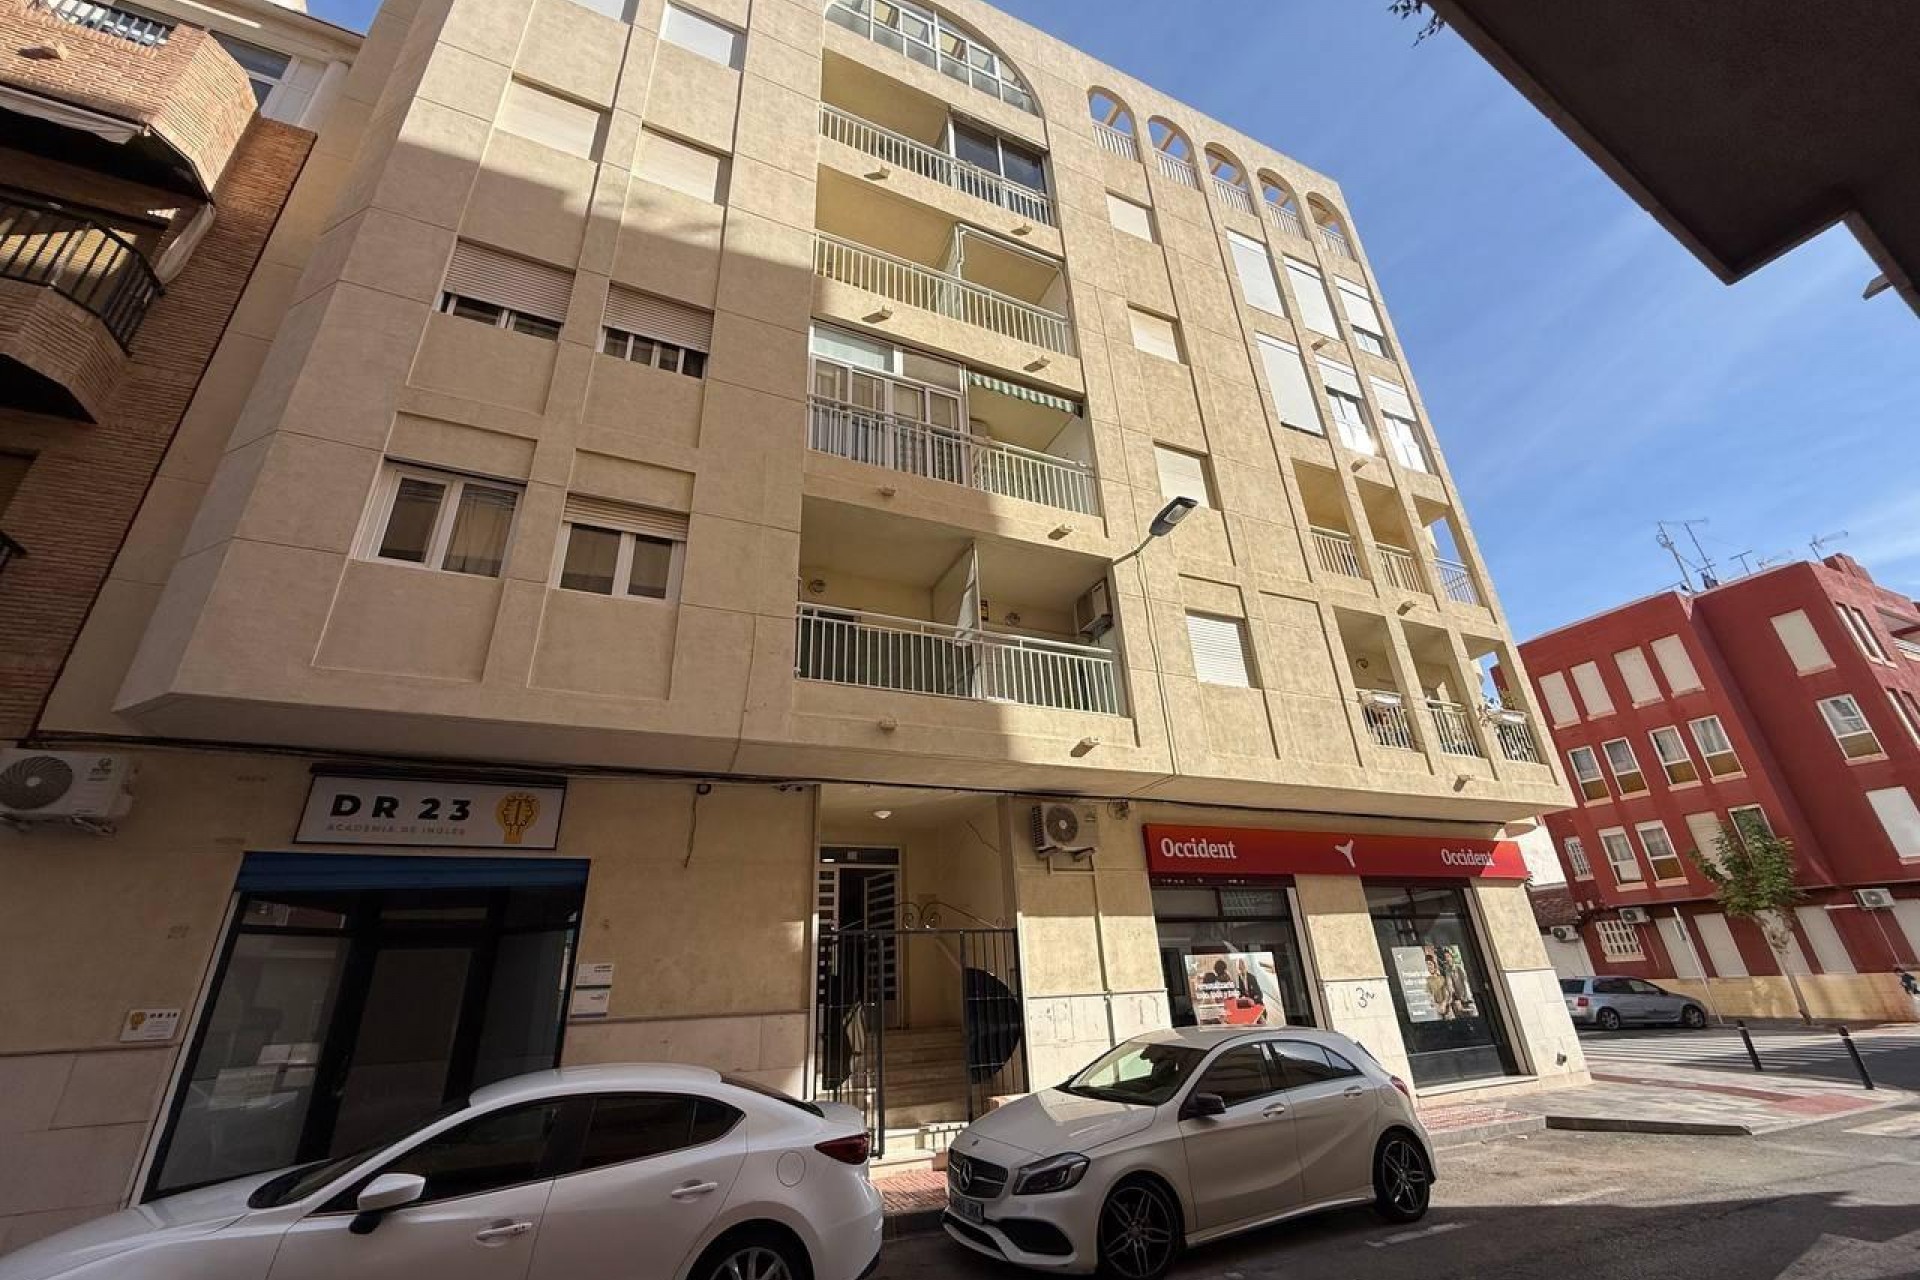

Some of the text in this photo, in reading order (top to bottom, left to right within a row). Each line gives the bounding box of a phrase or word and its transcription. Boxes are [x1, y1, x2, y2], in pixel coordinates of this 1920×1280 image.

[330, 794, 472, 820] DR 23
[1160, 837, 1237, 859] Occident
[1441, 848, 1495, 866] Occident
